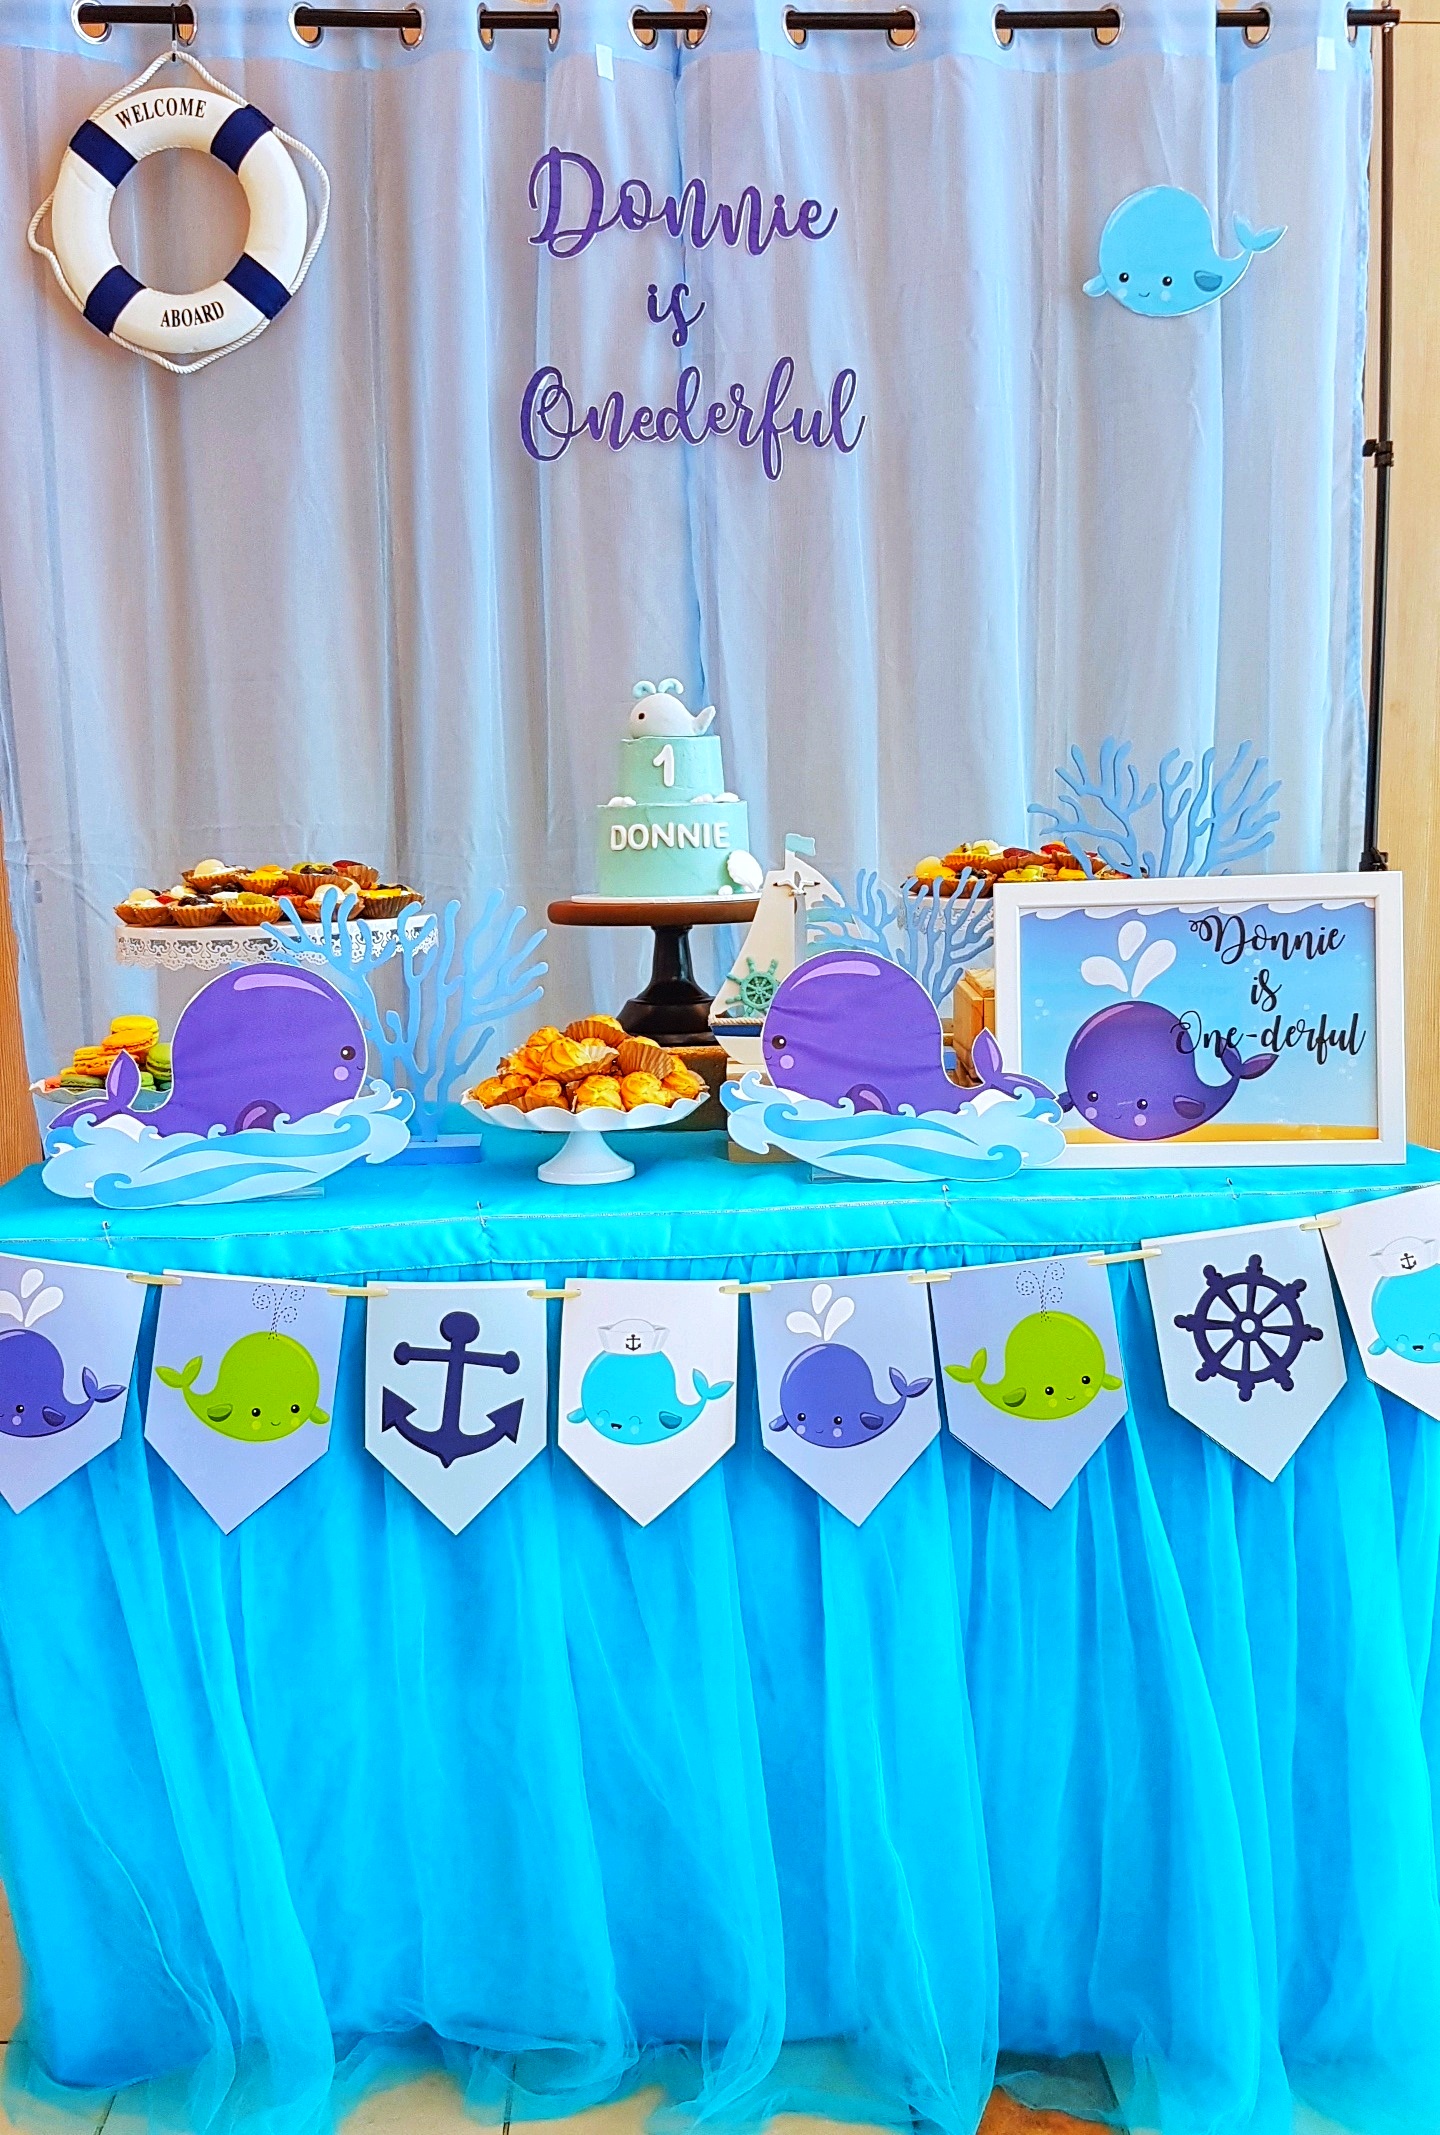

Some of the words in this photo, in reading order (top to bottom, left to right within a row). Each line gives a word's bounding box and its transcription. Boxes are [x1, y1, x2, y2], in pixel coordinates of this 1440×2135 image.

[116, 97, 207, 130] WELCOME
[528, 146, 838, 259] Donnie
[161, 301, 224, 328] ABOARD
[646, 281, 706, 348] is
[519, 355, 866, 481] Onederful
[653, 743, 675, 787] 1
[610, 822, 730, 851] DONNIE
[1188, 914, 1346, 965] Donnie
[1250, 967, 1282, 1012] is
[1169, 1010, 1367, 1066] One-derful
